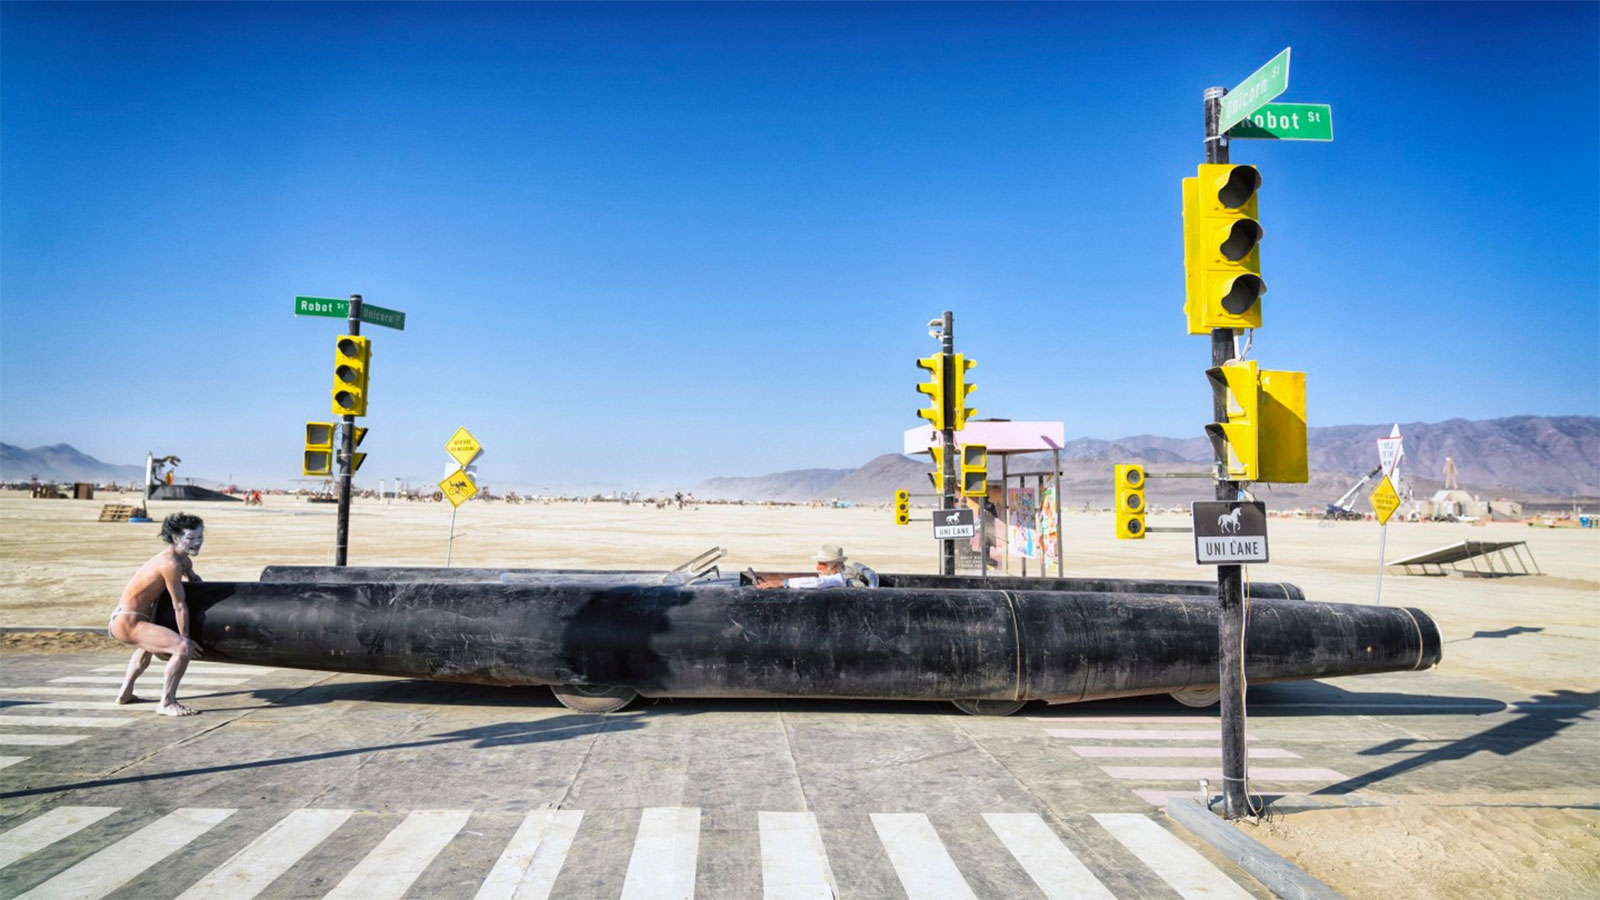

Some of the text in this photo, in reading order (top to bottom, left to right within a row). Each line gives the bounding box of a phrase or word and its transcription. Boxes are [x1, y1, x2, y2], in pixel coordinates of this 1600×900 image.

[1226, 64, 1281, 119] Unicorn St
[1307, 111, 1321, 122] St
[301, 300, 344, 312] Robot St
[939, 527, 969, 536] UNI LANE
[1206, 541, 1259, 556] UNI LANE
